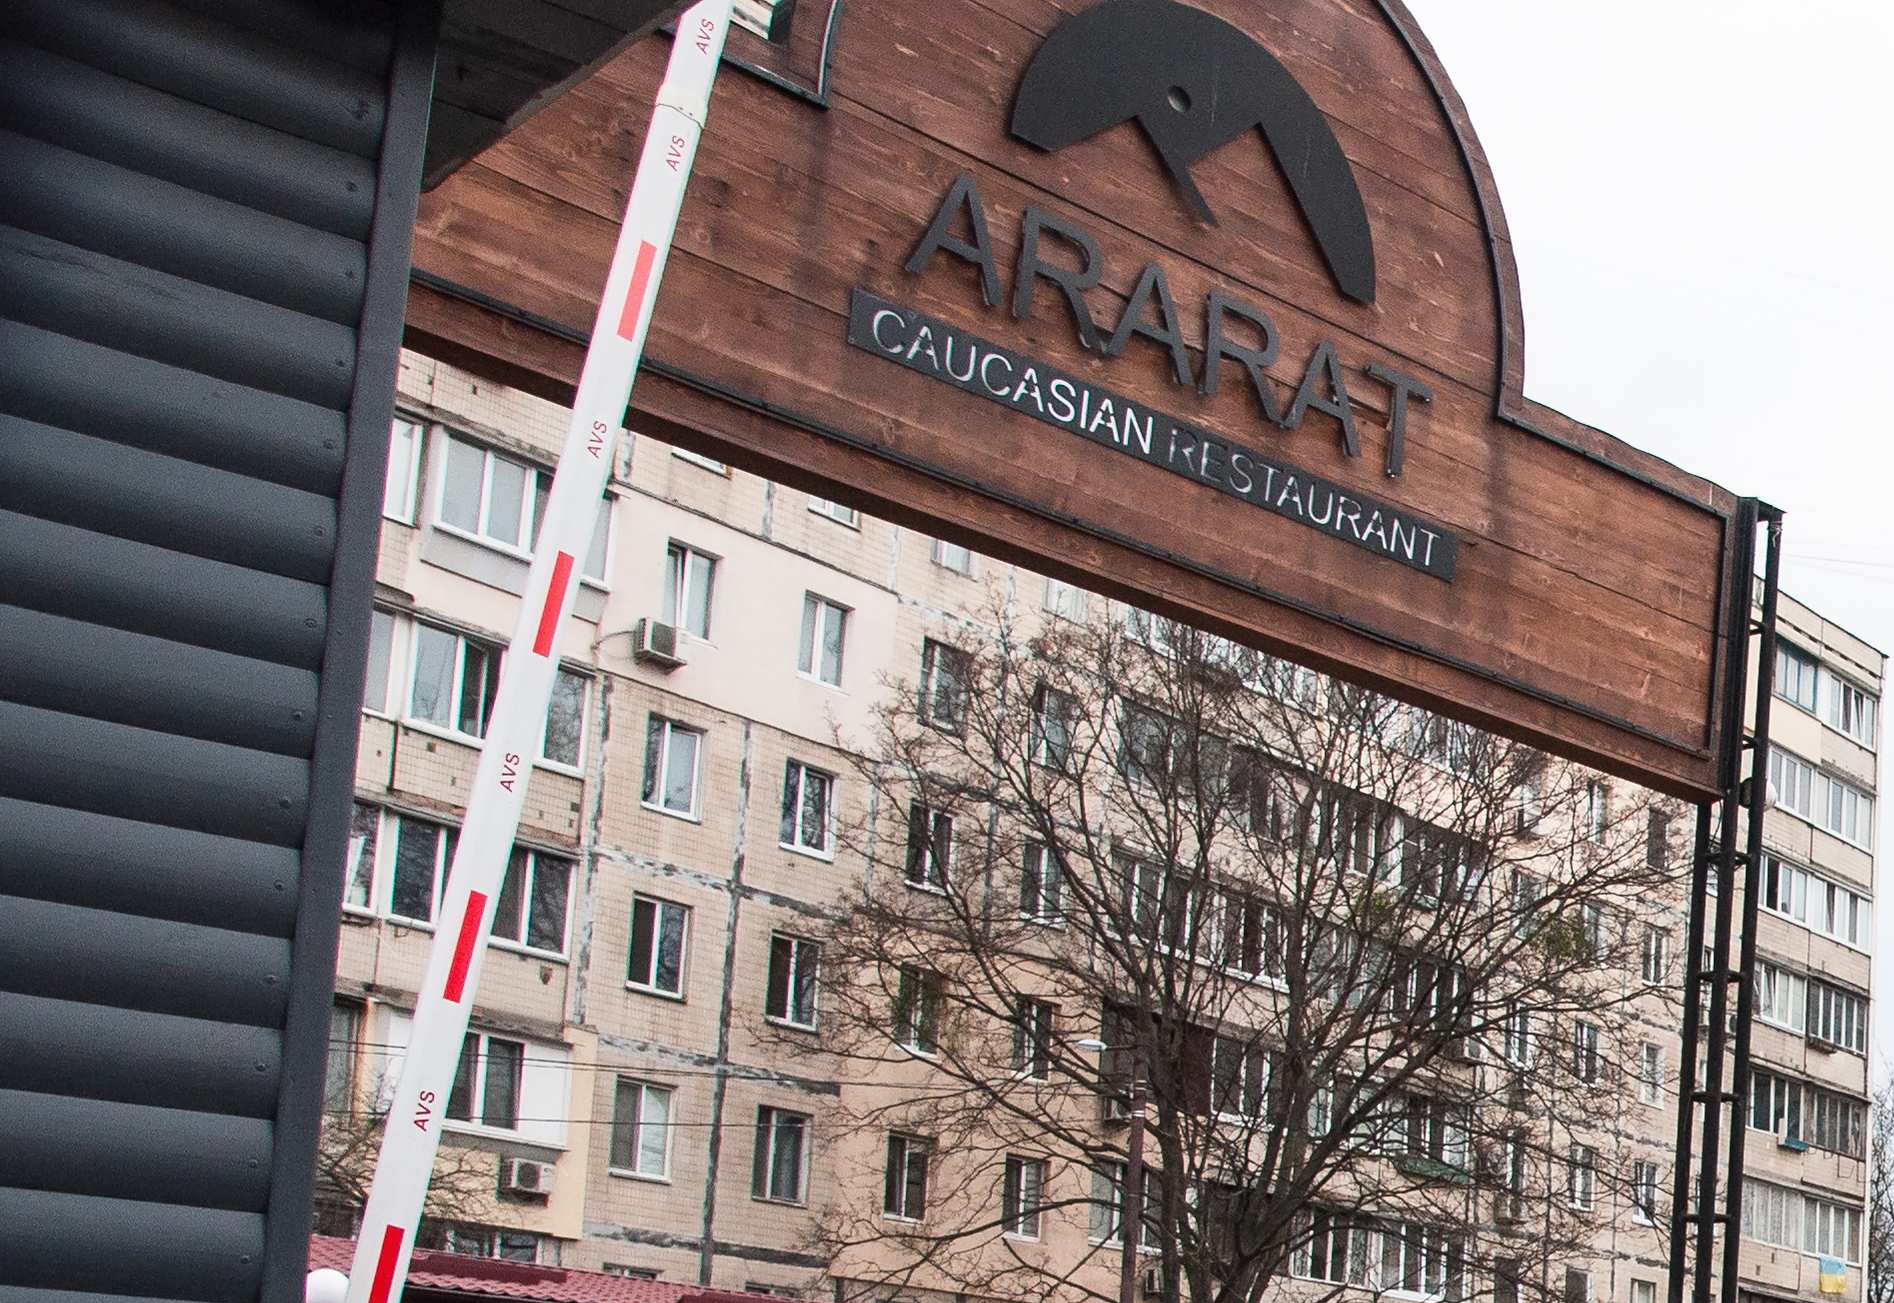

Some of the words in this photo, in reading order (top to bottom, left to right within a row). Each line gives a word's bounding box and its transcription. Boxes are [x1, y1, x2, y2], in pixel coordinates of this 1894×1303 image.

[696, 18, 715, 55] AVS
[666, 135, 685, 171] AVS
[905, 174, 1434, 478] ARARAT
[587, 420, 607, 459] AVS
[872, 309, 1154, 455] CAUCASIAN
[1168, 427, 1444, 567] RESTAURANT
[500, 752, 520, 793] AVS
[413, 1090, 435, 1132] AVS
